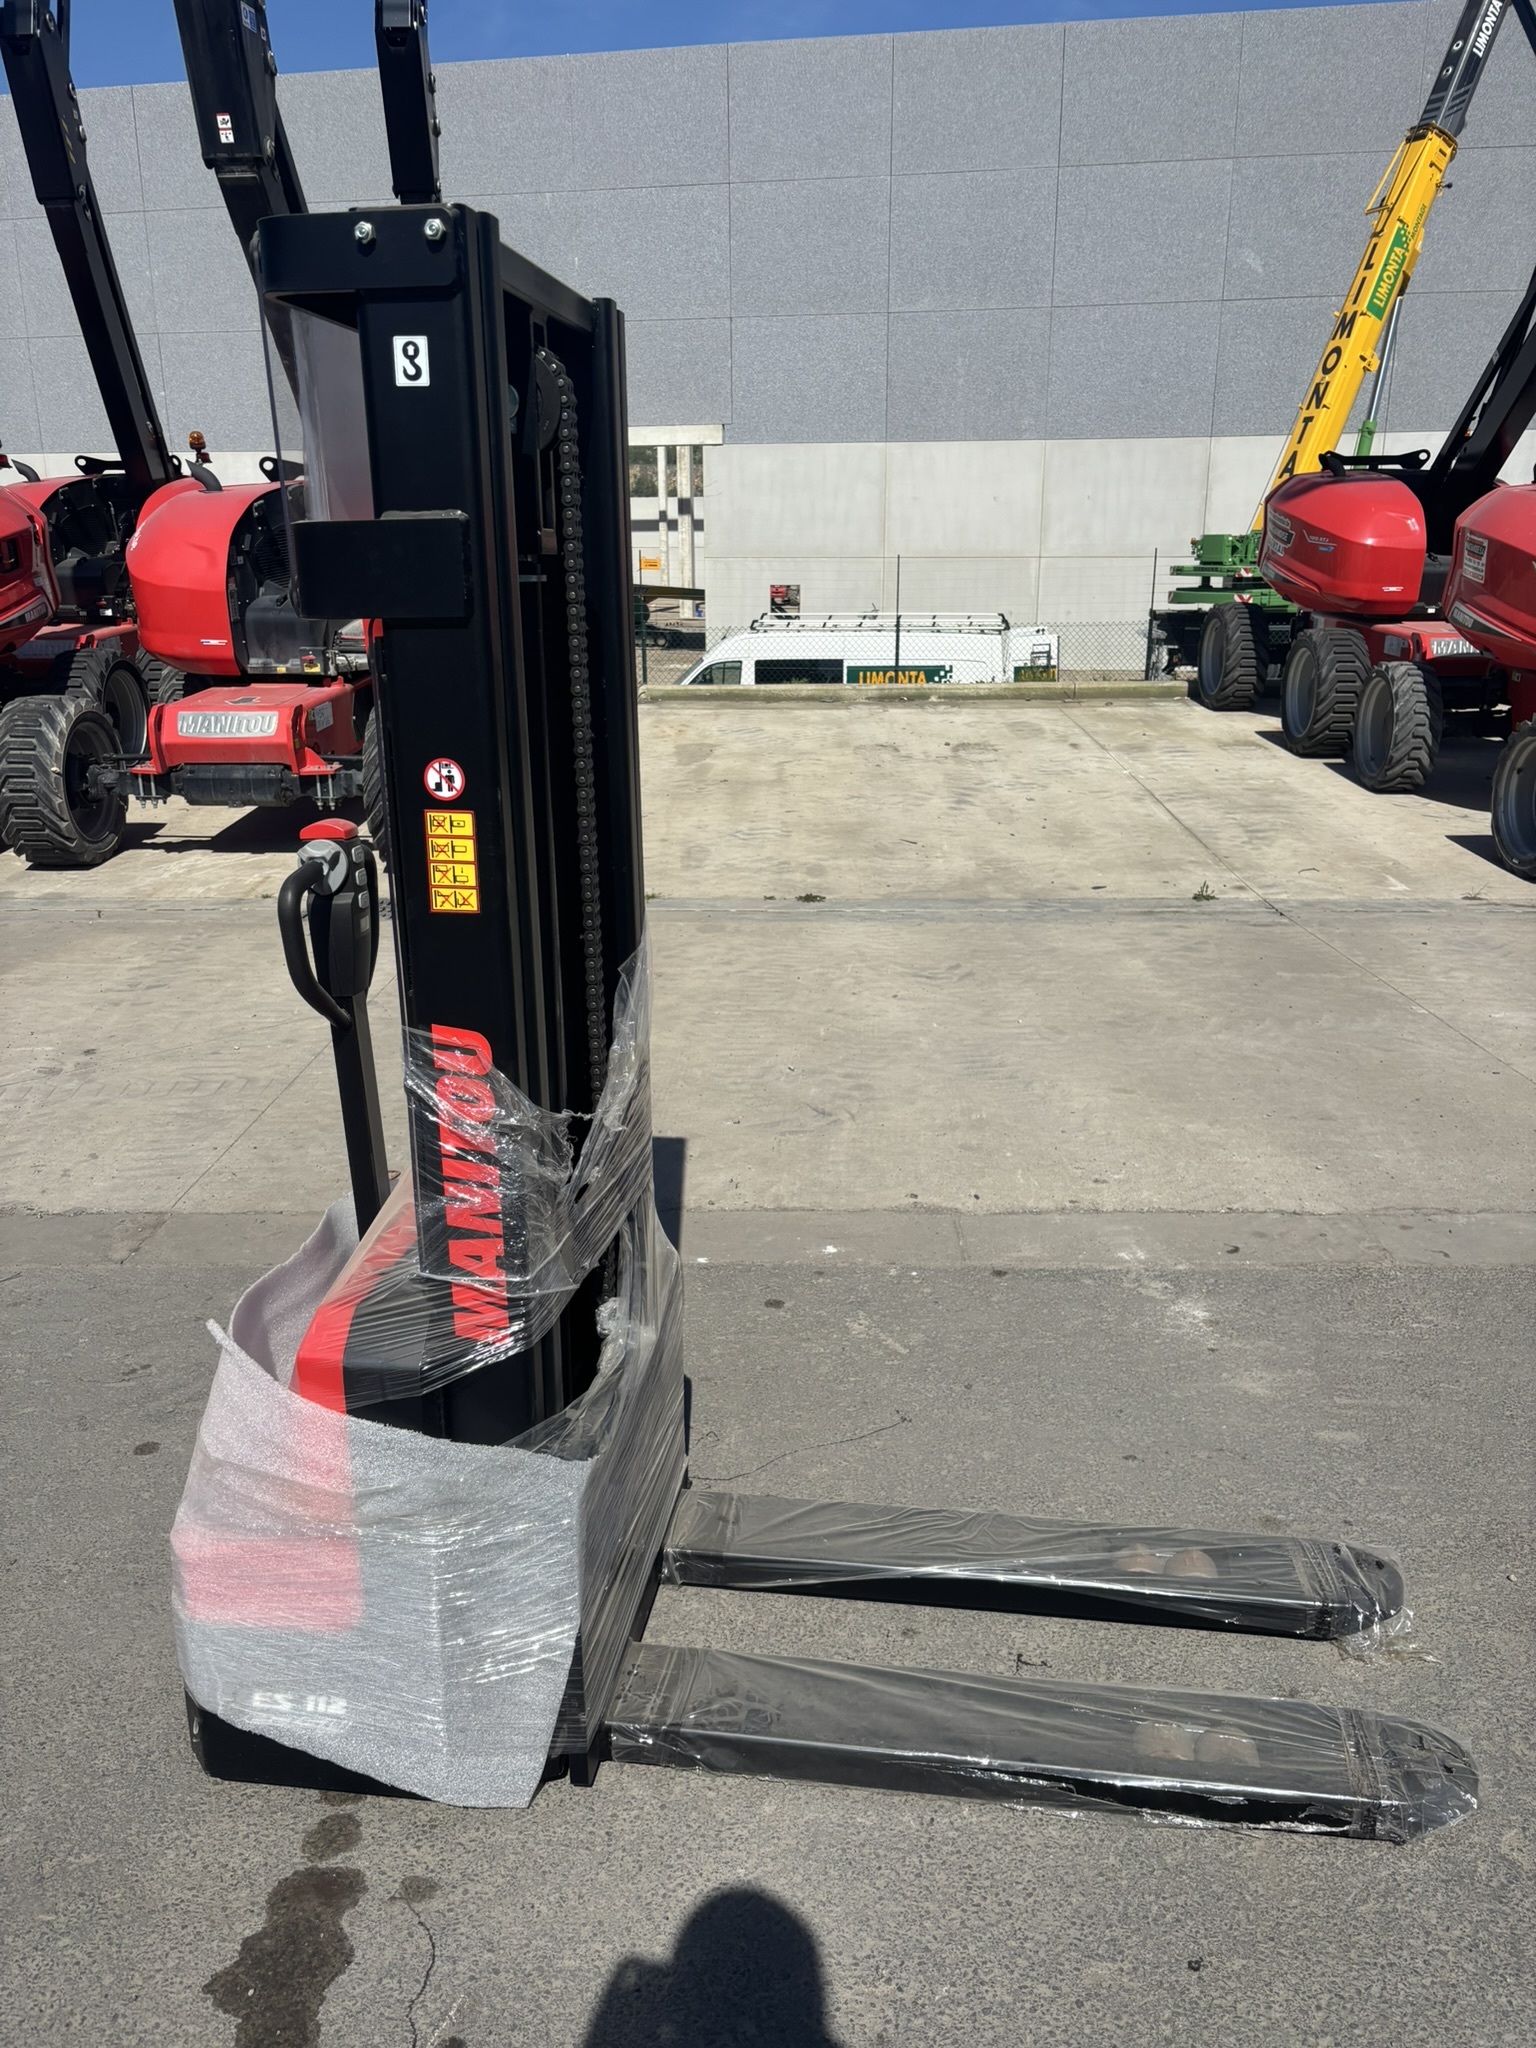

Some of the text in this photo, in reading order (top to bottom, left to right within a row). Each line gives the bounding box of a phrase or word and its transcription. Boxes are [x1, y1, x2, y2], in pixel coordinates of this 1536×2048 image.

[1472, 0, 1503, 58] LIMONTA
[1410, 203, 1428, 240] MONTAGE
[1373, 244, 1406, 308] LIMONTA
[1278, 243, 1378, 479] LIMONTA
[178, 715, 278, 734] MANITOU
[432, 1024, 509, 1345] MANITOU
